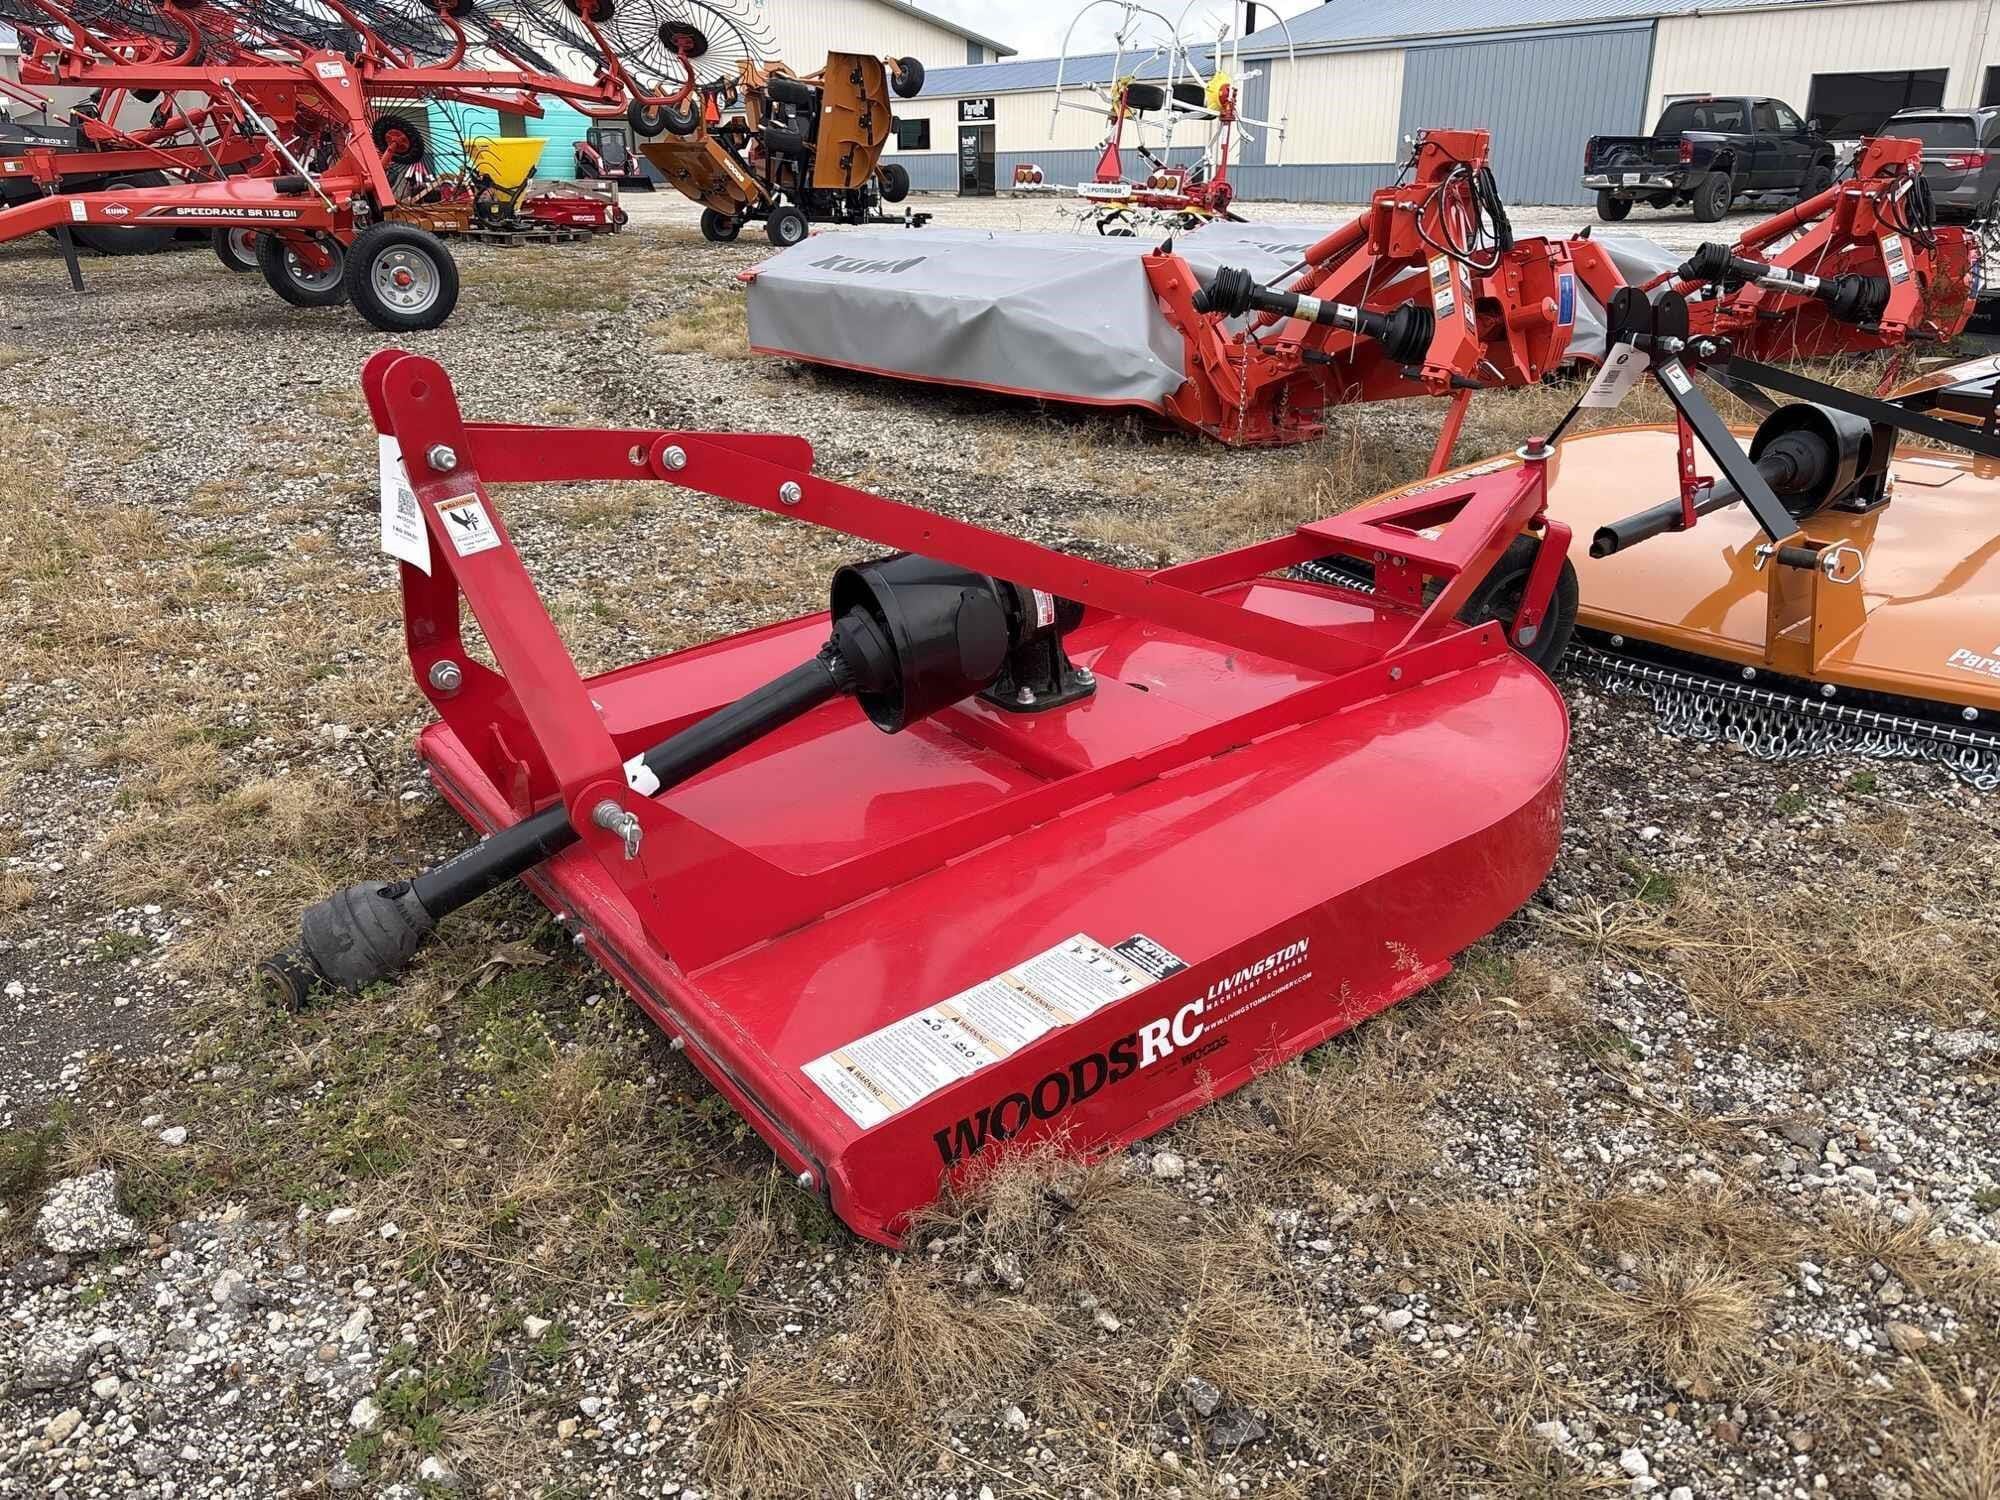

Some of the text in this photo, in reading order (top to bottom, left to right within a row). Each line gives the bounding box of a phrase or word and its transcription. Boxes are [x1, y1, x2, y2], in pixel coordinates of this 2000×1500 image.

[175, 206, 244, 217] SPEEDRAKE
[247, 208, 263, 217] SR
[264, 208, 281, 217] 112
[808, 254, 928, 274] KUHN
[1134, 938, 1181, 969] NOTICE
[1206, 936, 1310, 1000] LIVINGSTON
[1206, 954, 1309, 1012] MACHINERY COMPANY
[1023, 987, 1056, 1012] WARNING
[1203, 971, 1313, 1033] WWW.LIVINGSTONMACHINERY.COM
[959, 1019, 990, 1045] WARNING
[853, 1069, 884, 1098] WARNING
